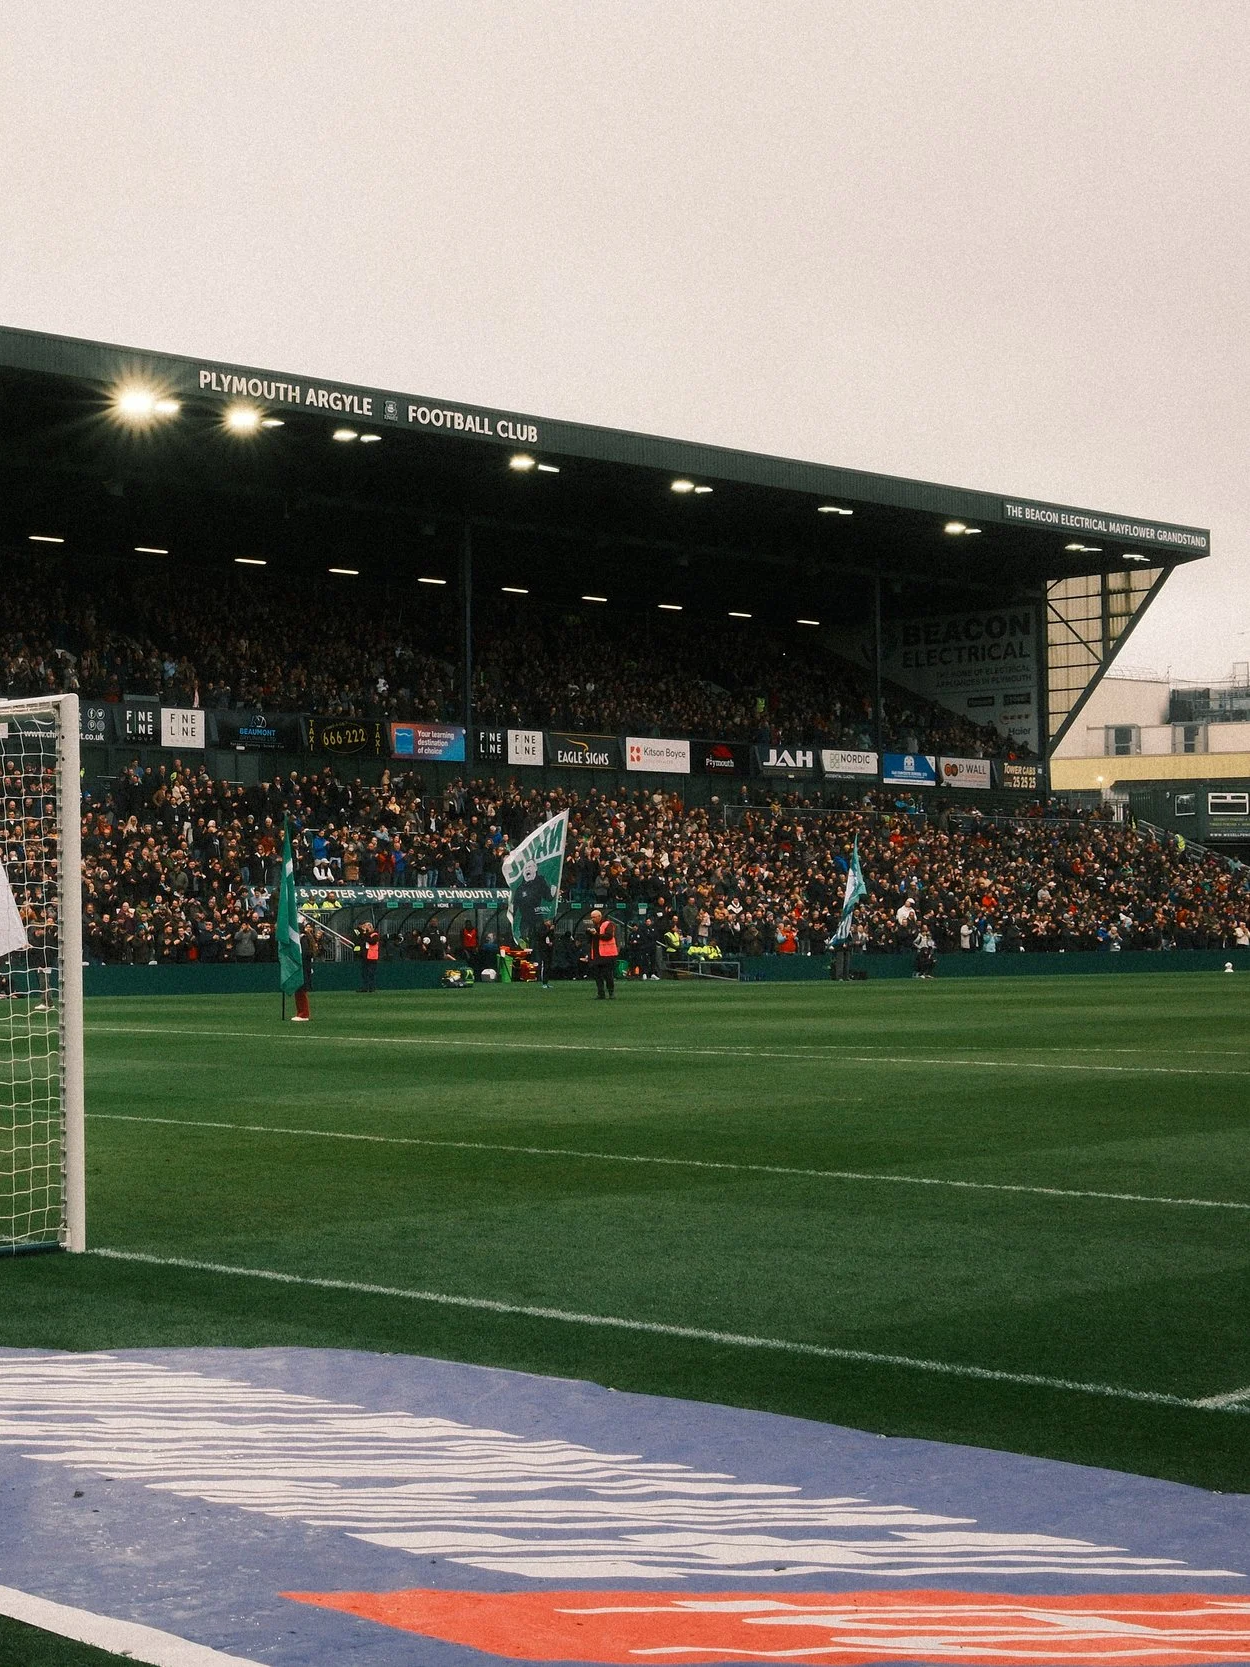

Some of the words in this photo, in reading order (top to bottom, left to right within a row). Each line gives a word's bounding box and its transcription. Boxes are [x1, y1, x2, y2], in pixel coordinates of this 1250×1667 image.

[199, 370, 301, 404] PLYMOUTH
[305, 388, 373, 417] ARGYLE
[408, 405, 494, 437] FOOTBALL
[497, 420, 539, 443] CLUB
[1006, 504, 1023, 519] THE
[1025, 507, 1059, 525] BEACON
[1060, 513, 1108, 533] ELECTRICAL
[1109, 521, 1156, 541] MAYFLOWER
[1156, 530, 1207, 549] GRANDSTAND
[902, 612, 1031, 647] BEACON
[902, 641, 1031, 669] ELECTRICAL
[239, 727, 276, 736] BEAUMONT
[417, 730, 431, 738] Your
[431, 731, 455, 741] learning
[417, 738, 449, 747] destination
[424, 747, 443, 755] choice
[643, 747, 665, 757] Kitson
[665, 748, 686, 760] Boyce
[557, 750, 583, 764] EAGLE
[585, 752, 609, 766] SIGNS
[705, 755, 735, 769] Plymouth
[841, 753, 870, 765] NORDIC
[966, 764, 987, 775] WALL
[1003, 762, 1022, 775] TOWER
[1022, 766, 1036, 776] CABS
[1013, 776, 1021, 788] 25
[1021, 776, 1029, 789] 25
[1029, 777, 1037, 789] 25
[300, 888, 310, 898] &
[310, 888, 356, 898] POTTER
[365, 888, 435, 900] SUPPORTING
[438, 890, 493, 899] PLYMOUTH
